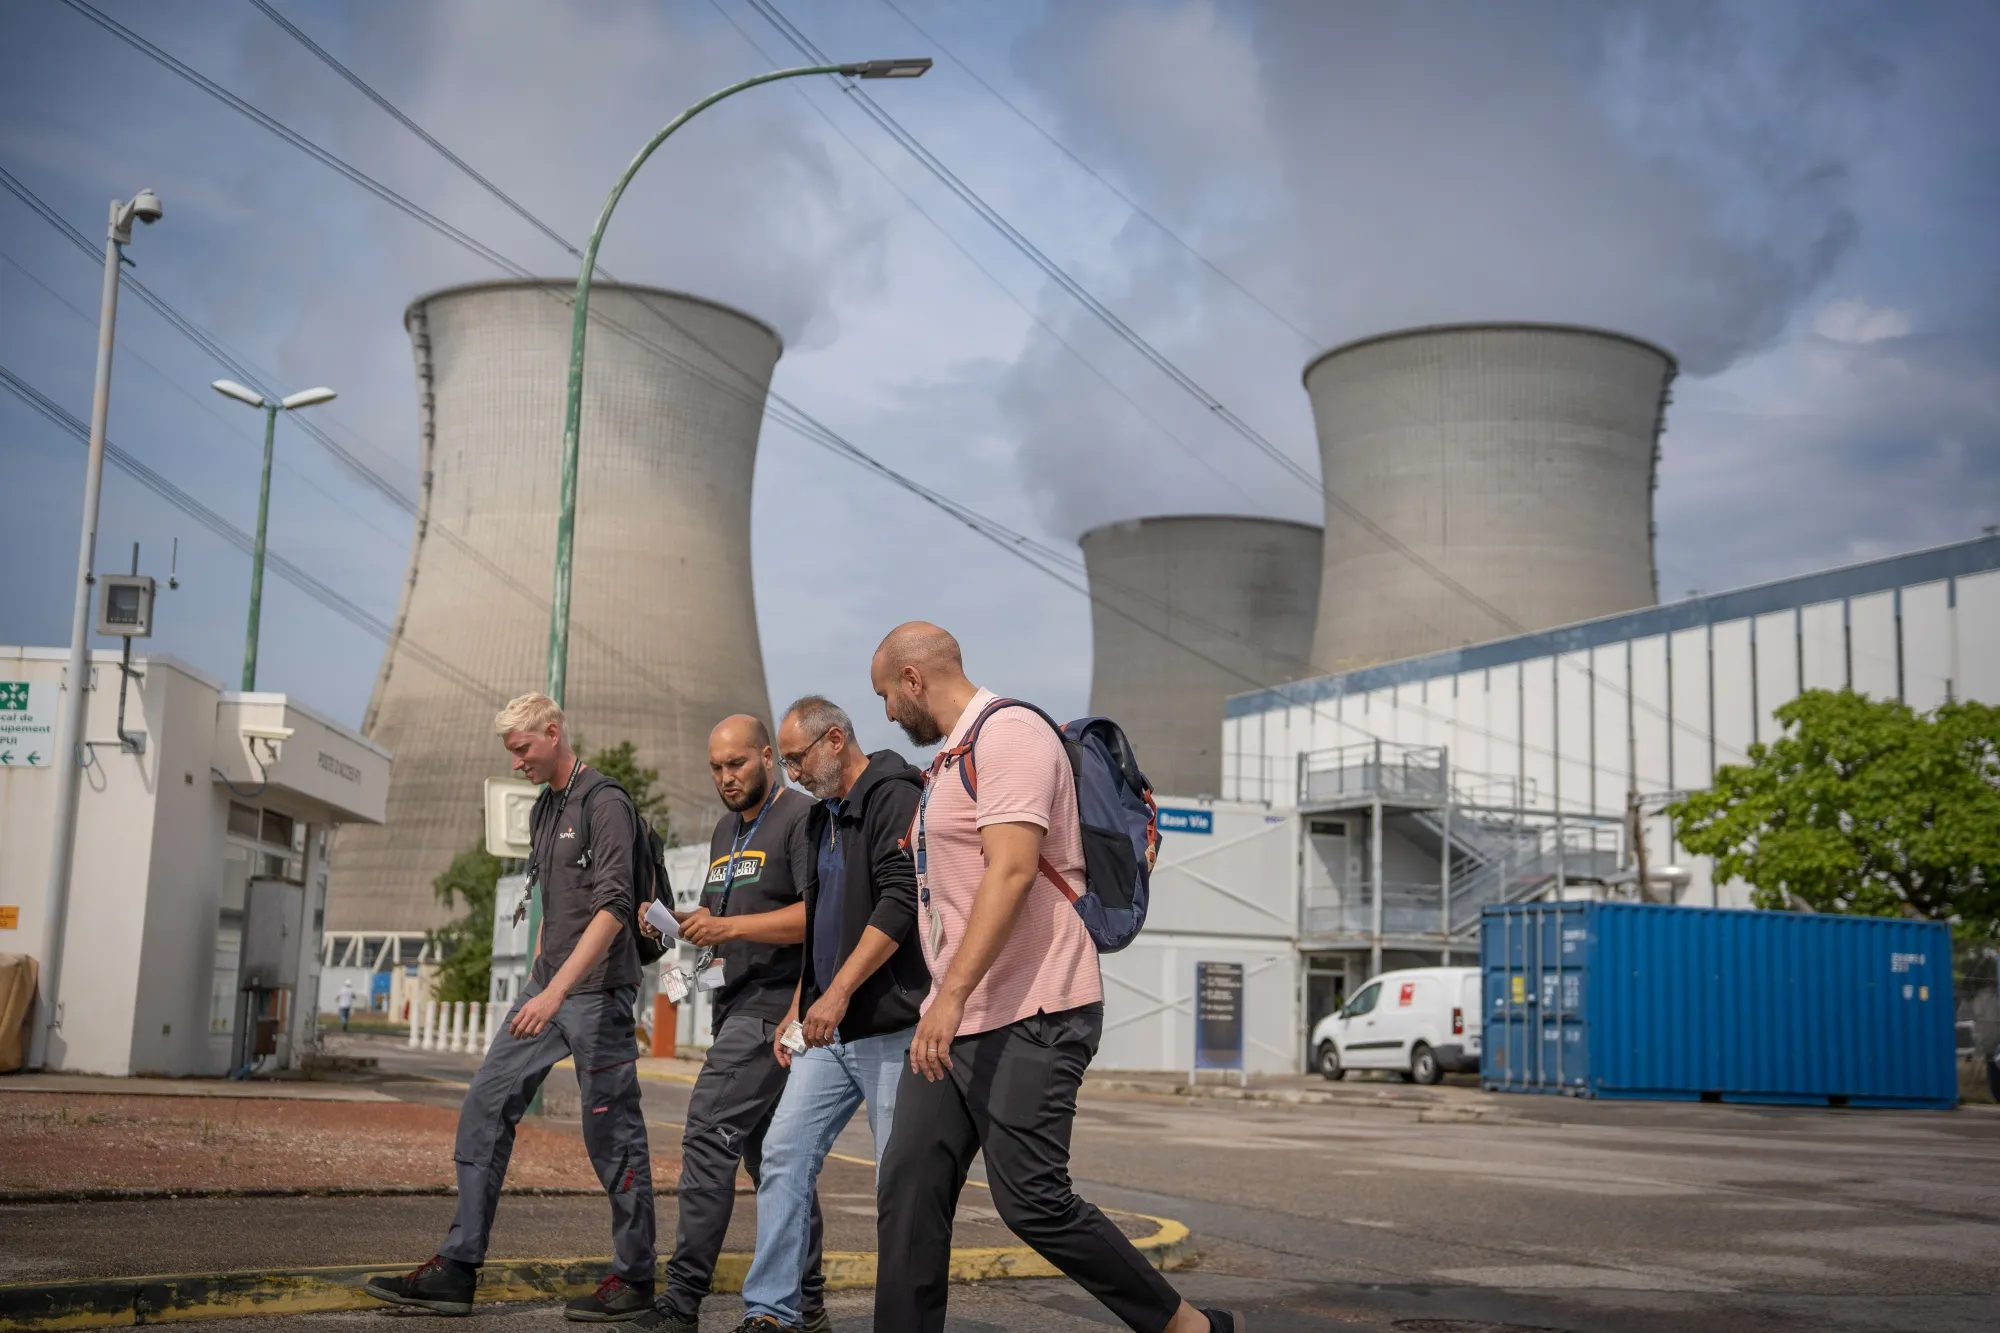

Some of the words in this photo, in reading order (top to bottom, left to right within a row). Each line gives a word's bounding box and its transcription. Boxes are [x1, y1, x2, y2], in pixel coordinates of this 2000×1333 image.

[20, 713, 34, 722] de
[1160, 813, 1188, 827] Base
[1188, 815, 1209, 829] Vie
